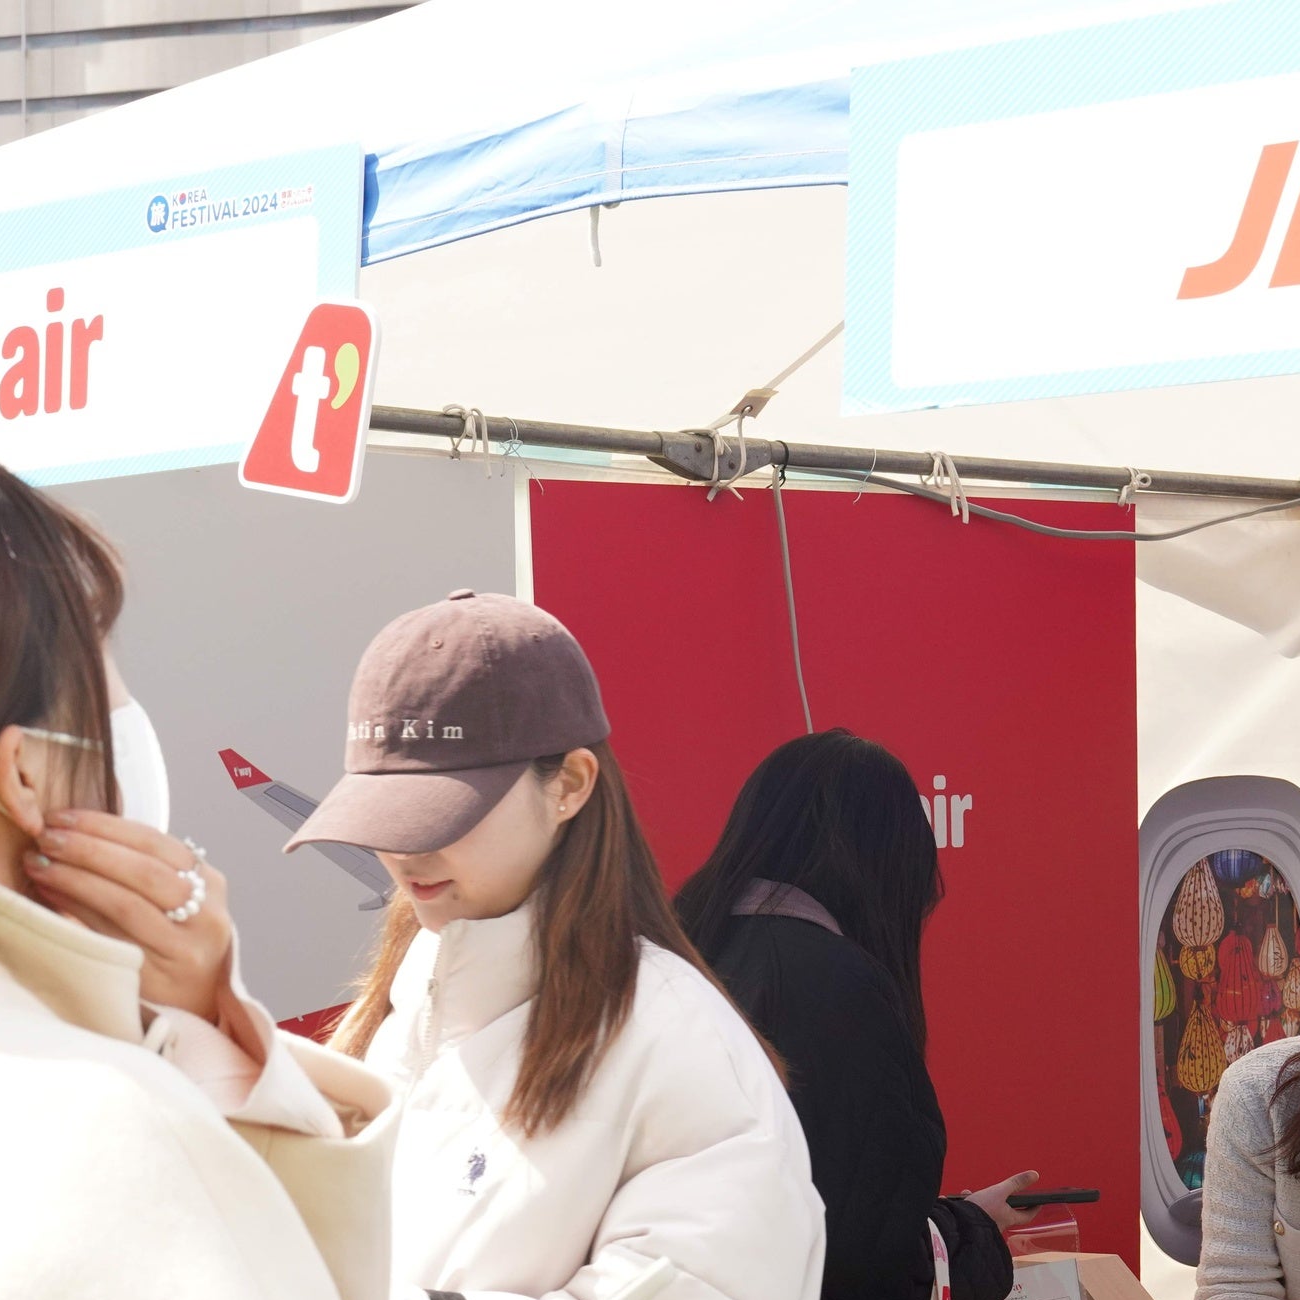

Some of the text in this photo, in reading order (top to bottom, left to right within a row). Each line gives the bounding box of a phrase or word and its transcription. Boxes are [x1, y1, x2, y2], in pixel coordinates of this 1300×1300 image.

[171, 201, 239, 230] FESTIVAL
[241, 192, 279, 217] 2024
[401, 718, 464, 740] Kim
